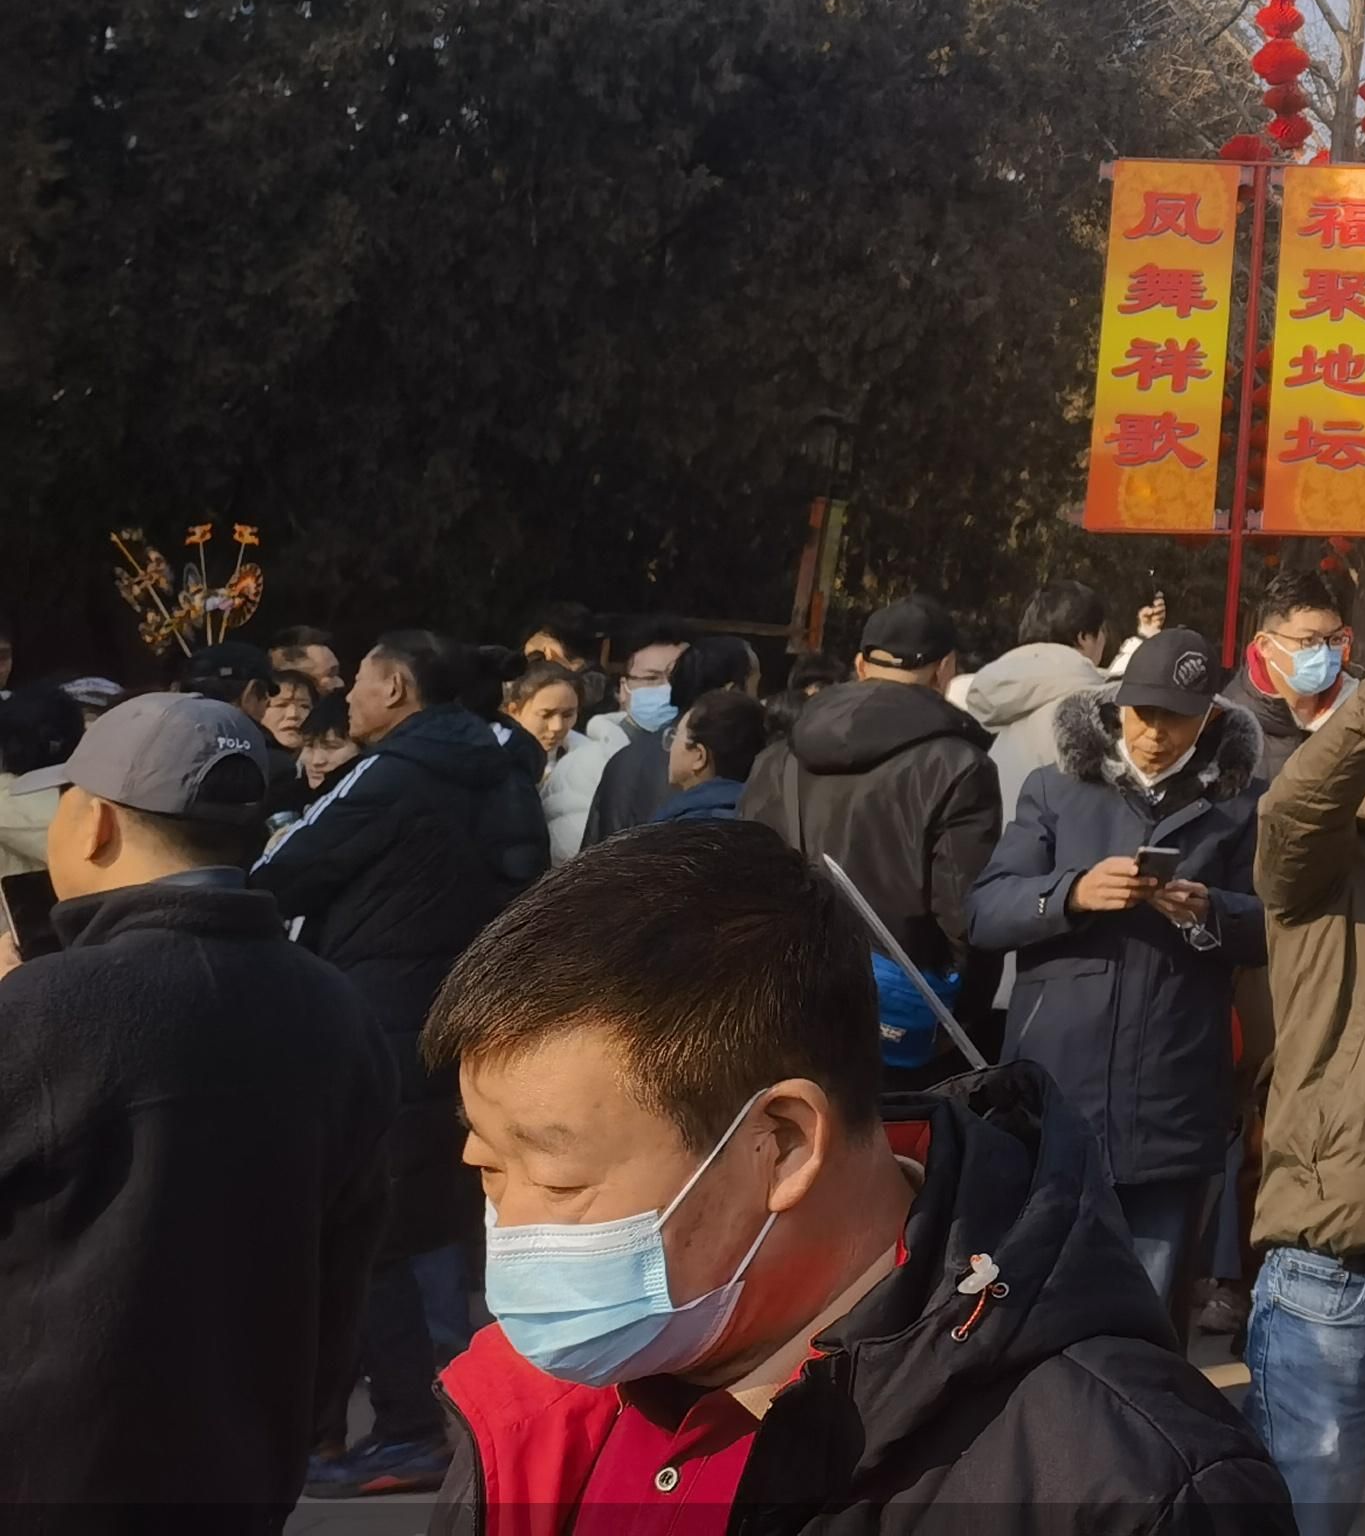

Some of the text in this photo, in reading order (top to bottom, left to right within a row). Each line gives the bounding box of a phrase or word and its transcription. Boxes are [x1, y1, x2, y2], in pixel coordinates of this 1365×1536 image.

[1104, 191, 1224, 470] 凤舞祥歌
[217, 736, 251, 751] POLO
